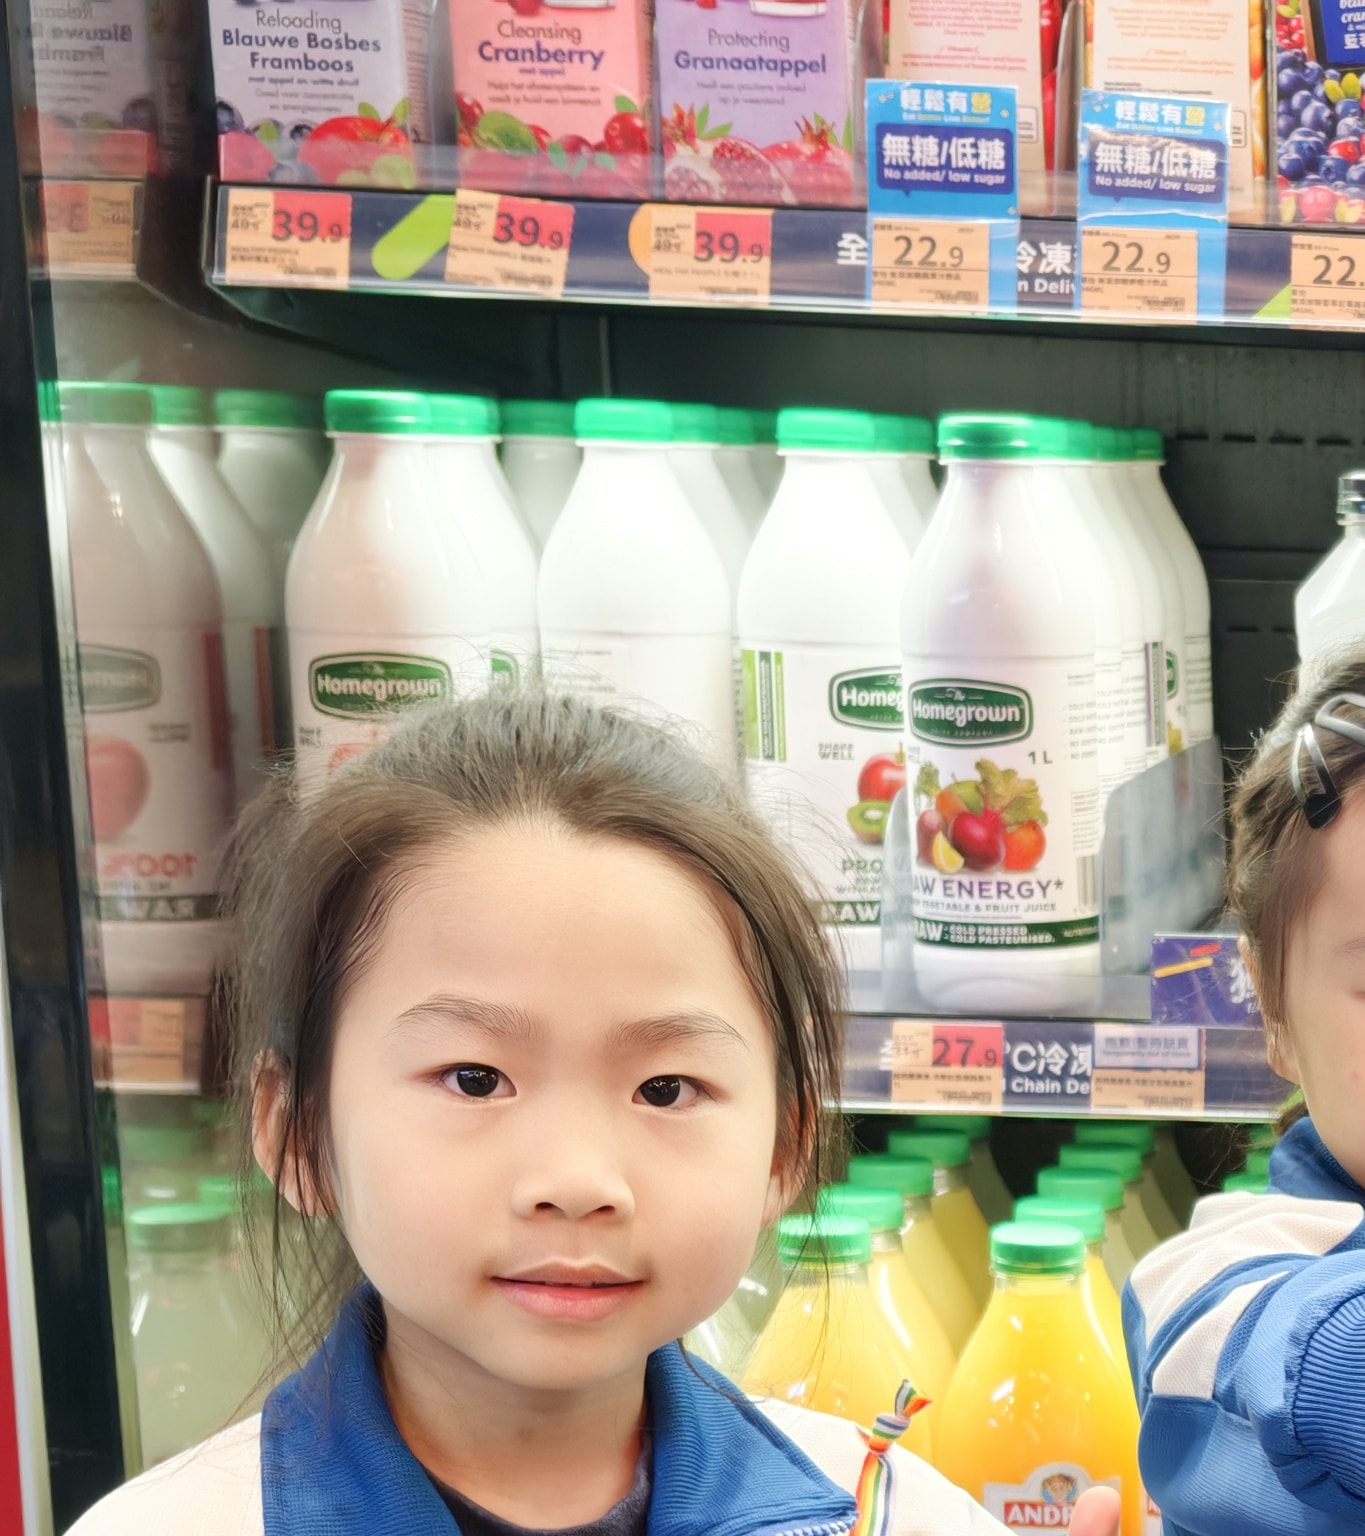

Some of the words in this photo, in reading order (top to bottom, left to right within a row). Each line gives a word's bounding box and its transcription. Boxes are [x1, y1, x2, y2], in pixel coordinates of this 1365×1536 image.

[256, 9, 342, 34] Reloading
[497, 20, 582, 43] Cleansing
[222, 29, 299, 49] Blauwe
[307, 32, 381, 52] Bosbes
[708, 29, 790, 52] Protecting
[250, 52, 354, 73] Framboos
[478, 41, 605, 70] Cranberry
[674, 51, 826, 77] Granaatappel
[272, 210, 343, 243] 39.9
[495, 212, 564, 250] 39.9
[694, 231, 764, 263] 39.9
[893, 235, 964, 269] 22.9
[1100, 241, 1172, 275] 22.9
[318, 673, 442, 700] Homegrown
[913, 699, 1021, 728] Homegrown
[1012, 1078, 1061, 1095] Chain
